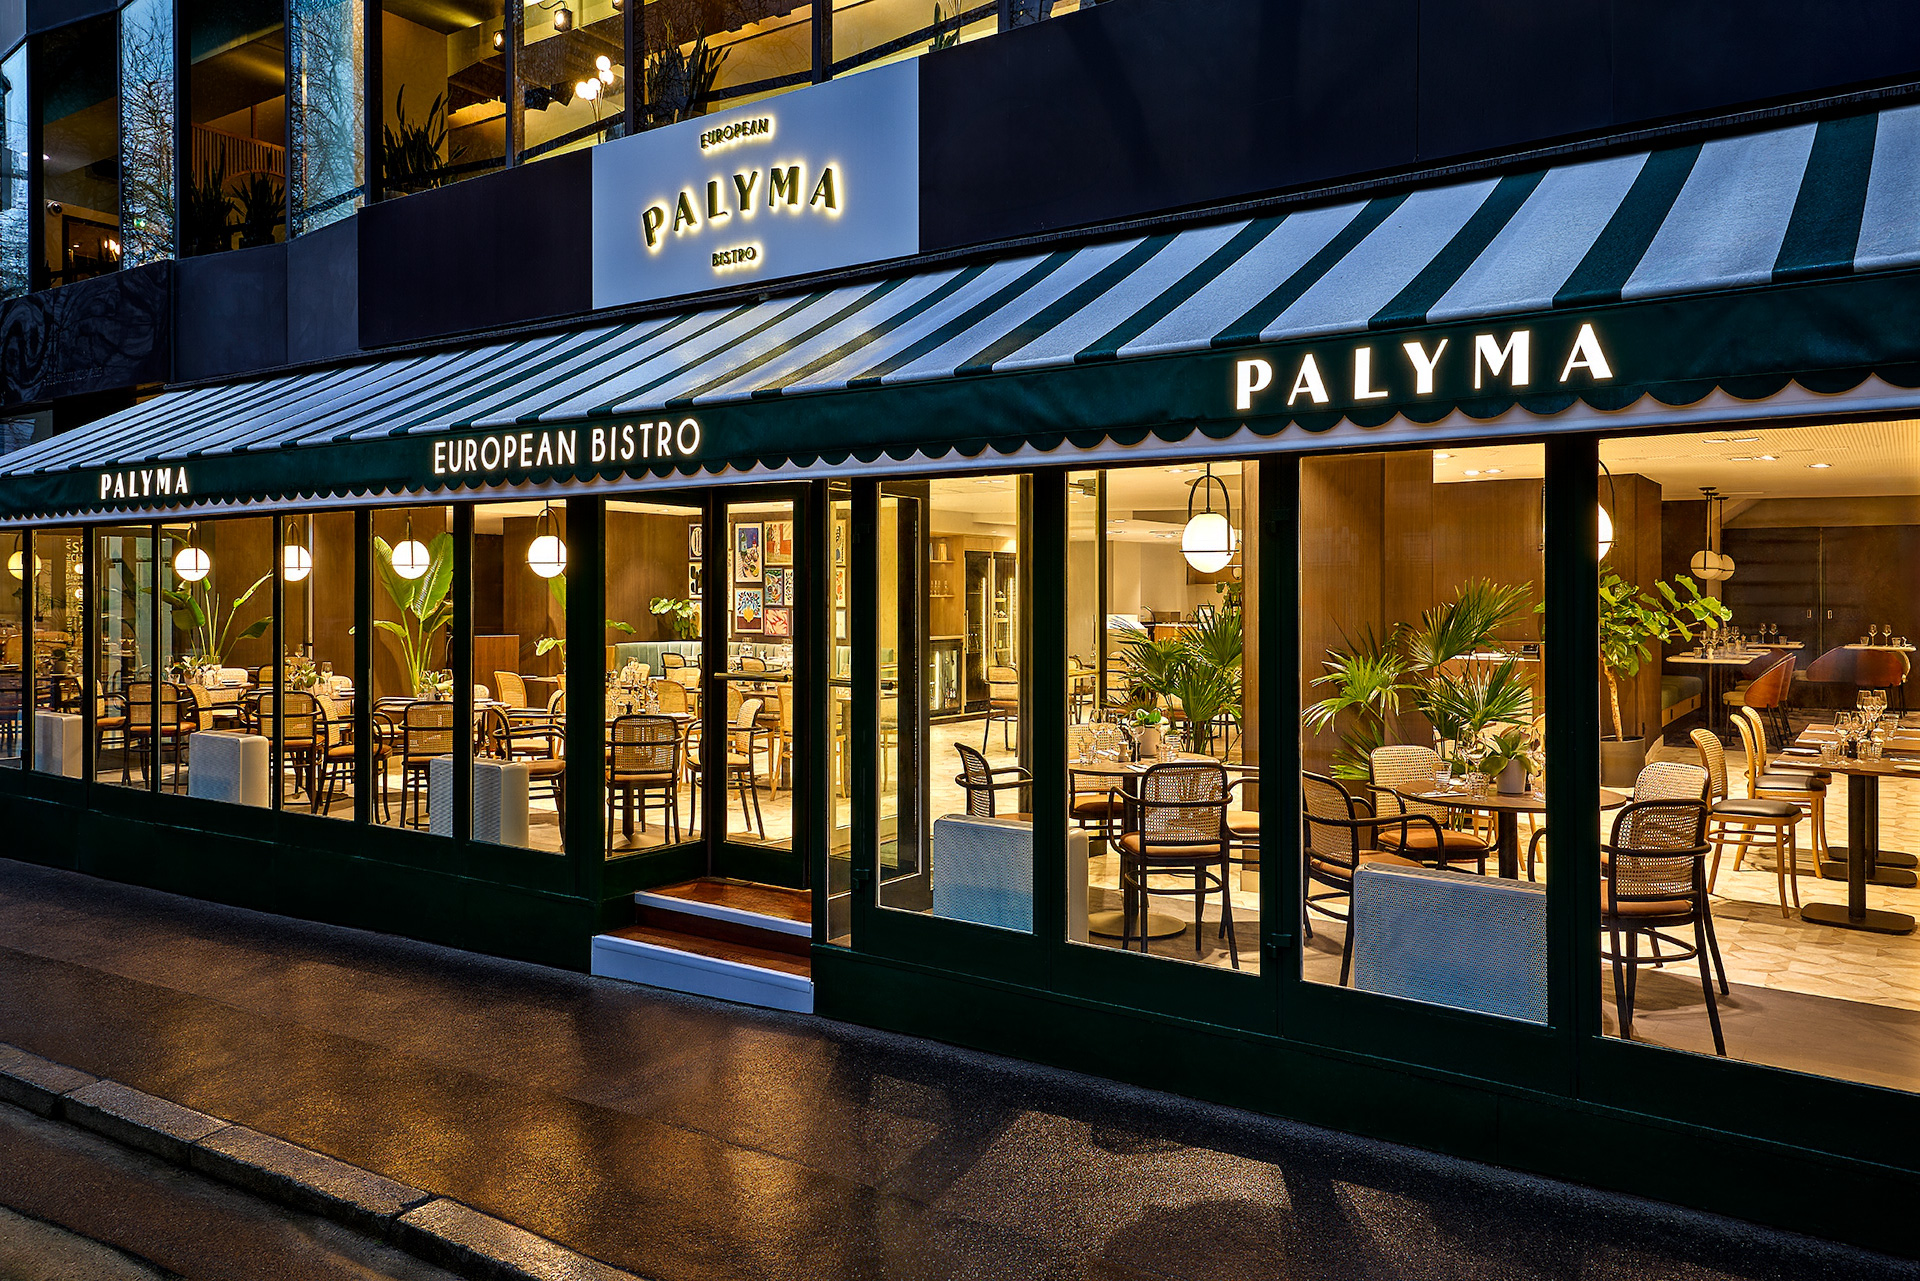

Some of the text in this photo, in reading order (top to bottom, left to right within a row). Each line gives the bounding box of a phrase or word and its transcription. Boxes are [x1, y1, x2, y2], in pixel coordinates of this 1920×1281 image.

[700, 118, 769, 149] EUROPEAN
[642, 166, 837, 247] PALYMA
[711, 246, 757, 267] BISTRO
[1236, 323, 1613, 411] PALYMA
[433, 418, 701, 475] EUROPEAN BISTRO
[100, 466, 189, 500] PALYMA
